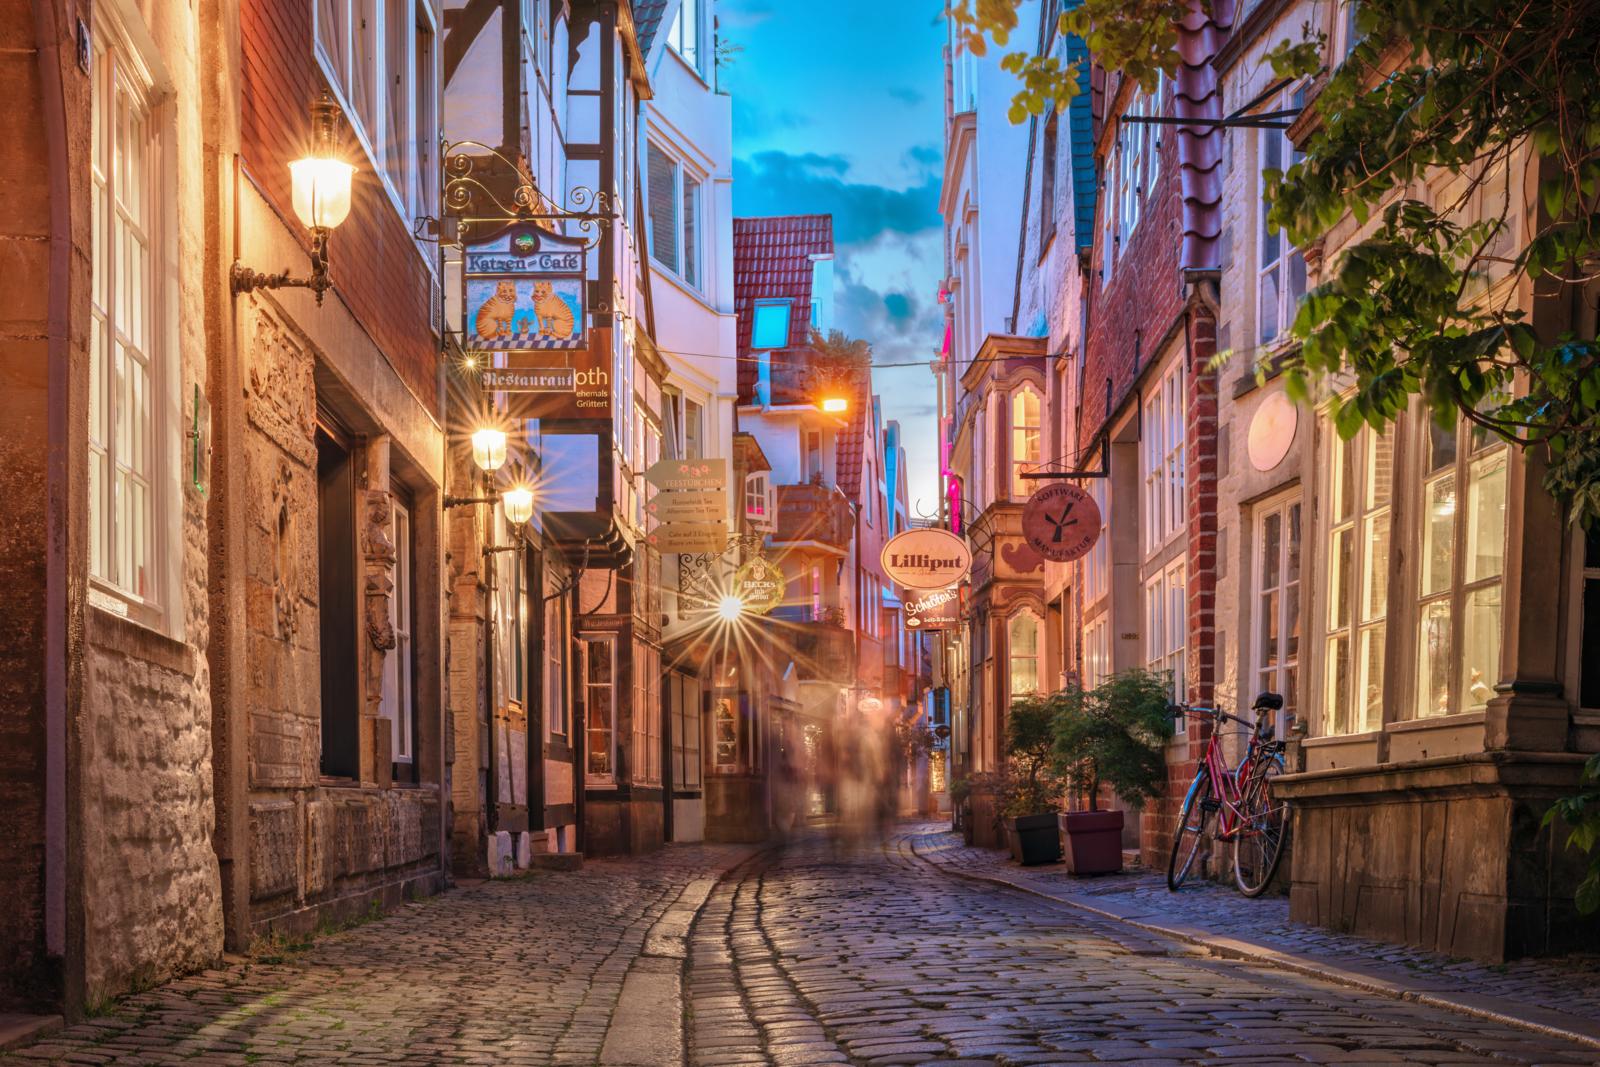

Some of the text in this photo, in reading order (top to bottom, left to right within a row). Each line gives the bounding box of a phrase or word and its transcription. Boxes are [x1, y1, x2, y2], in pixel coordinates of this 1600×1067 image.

[482, 372, 573, 387] Restaurant
[576, 400, 608, 408] Grüttert
[890, 554, 963, 572] Lilliput
